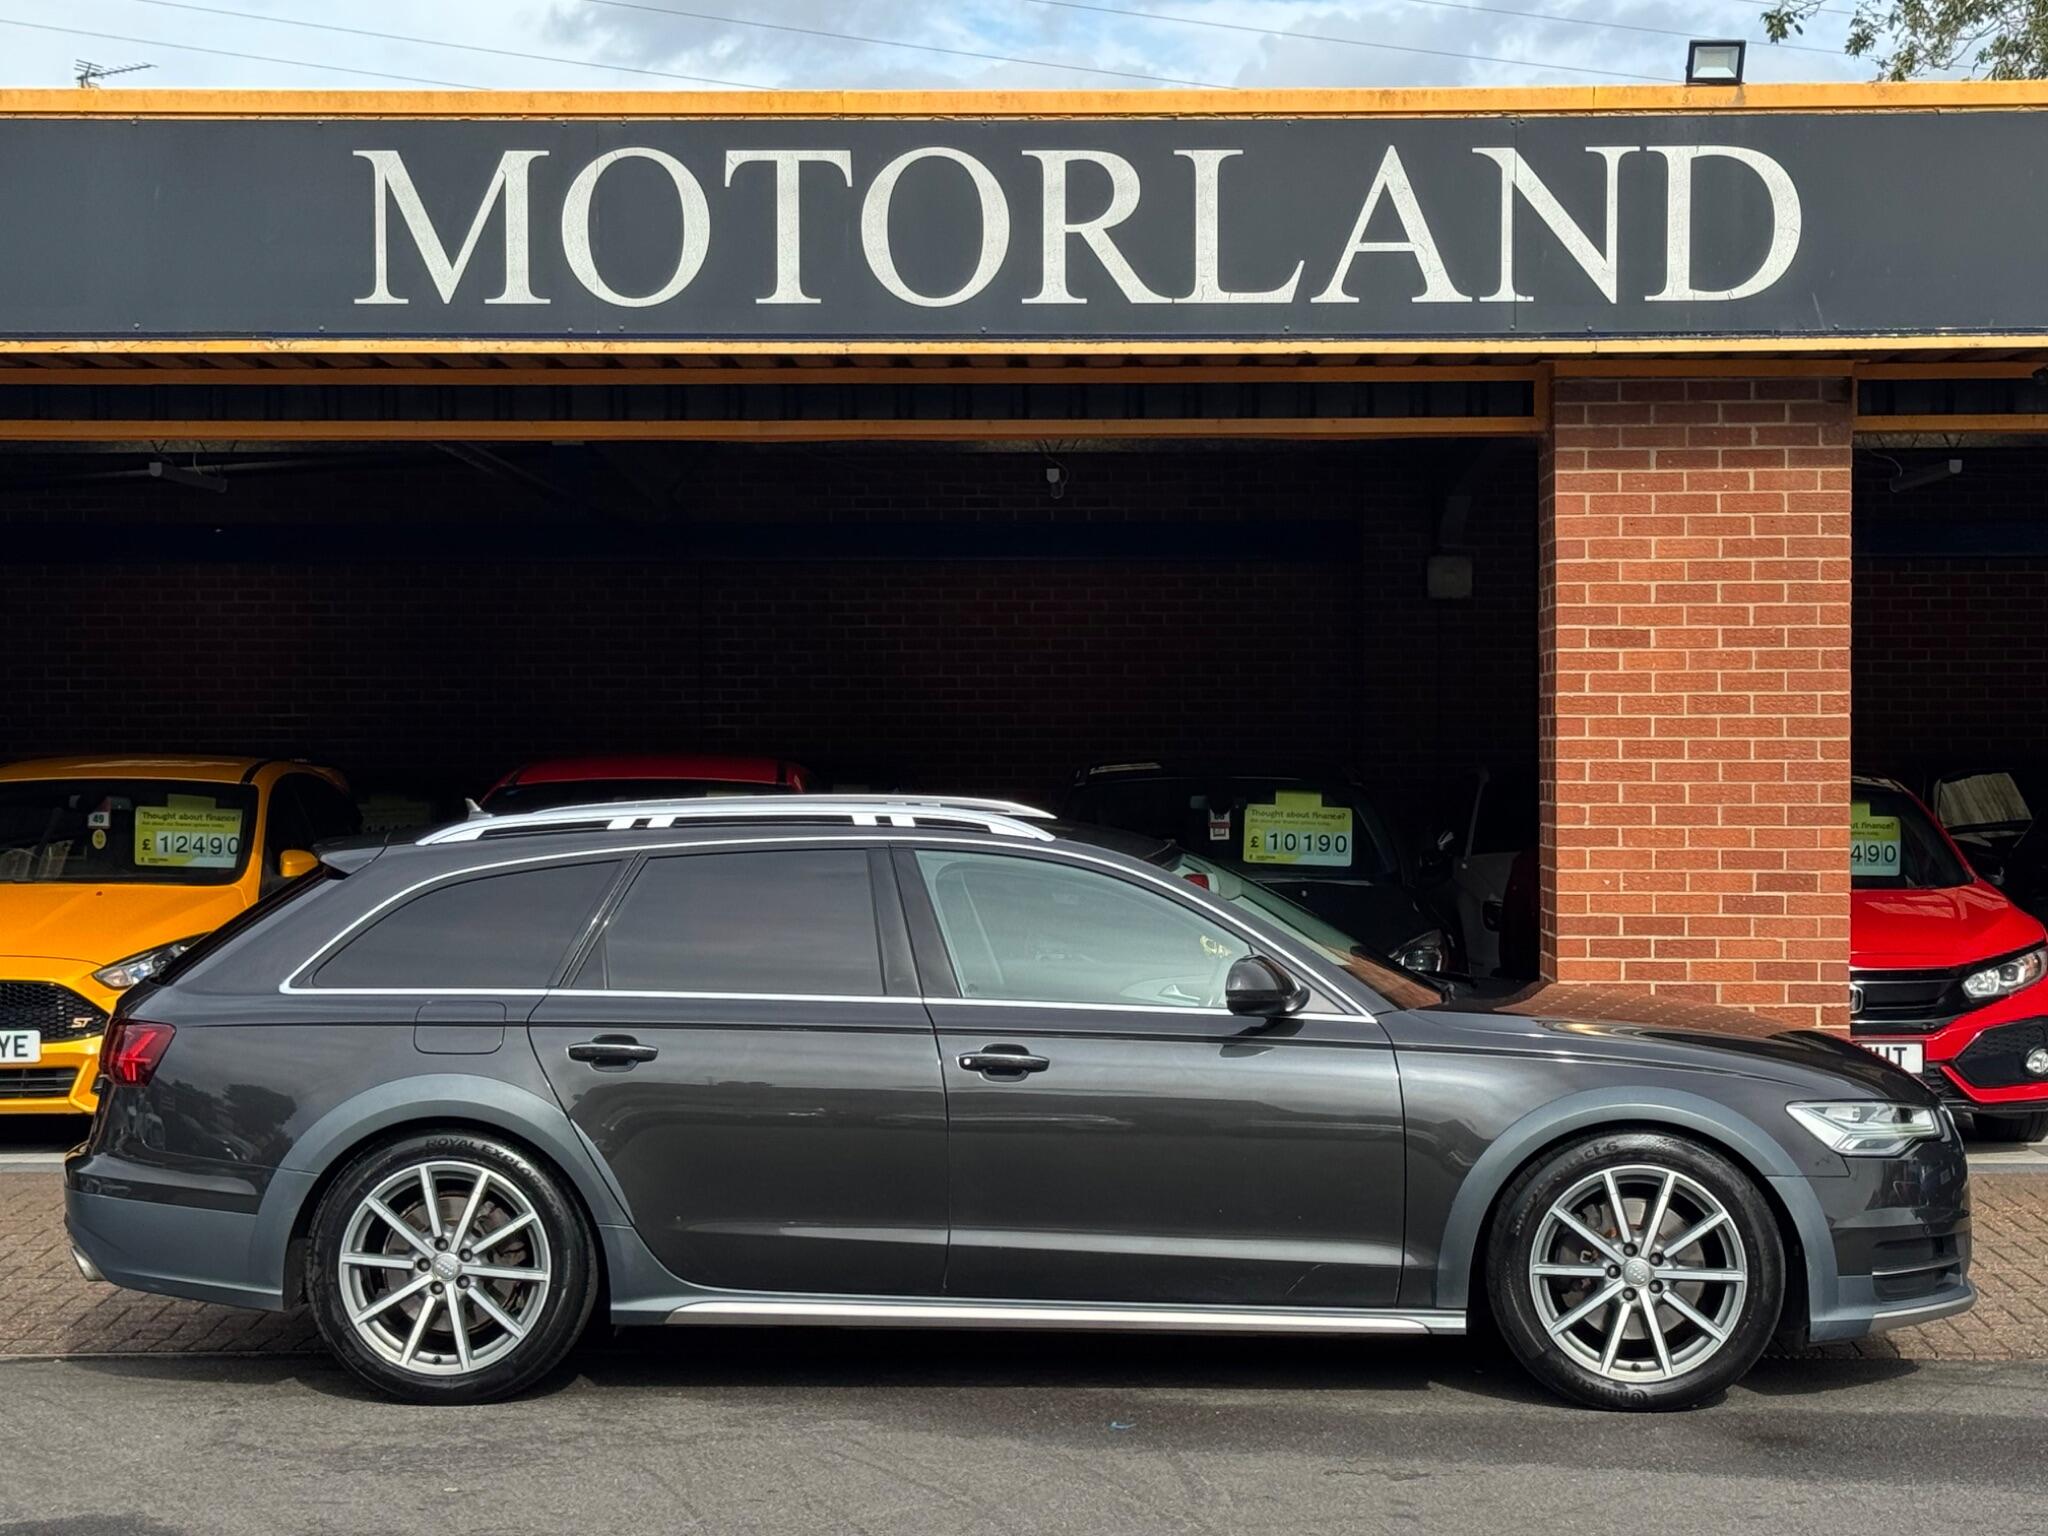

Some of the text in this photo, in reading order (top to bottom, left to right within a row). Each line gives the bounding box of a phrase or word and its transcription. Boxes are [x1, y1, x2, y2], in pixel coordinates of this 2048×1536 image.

[353, 145, 1803, 309] MOTORLAND
[142, 811, 177, 822] Thought
[179, 813, 203, 822] about
[1251, 809, 1284, 820] Thought
[1286, 811, 1310, 820] about
[70, 1017, 94, 1029] ST
[0, 1035, 29, 1058] YE
